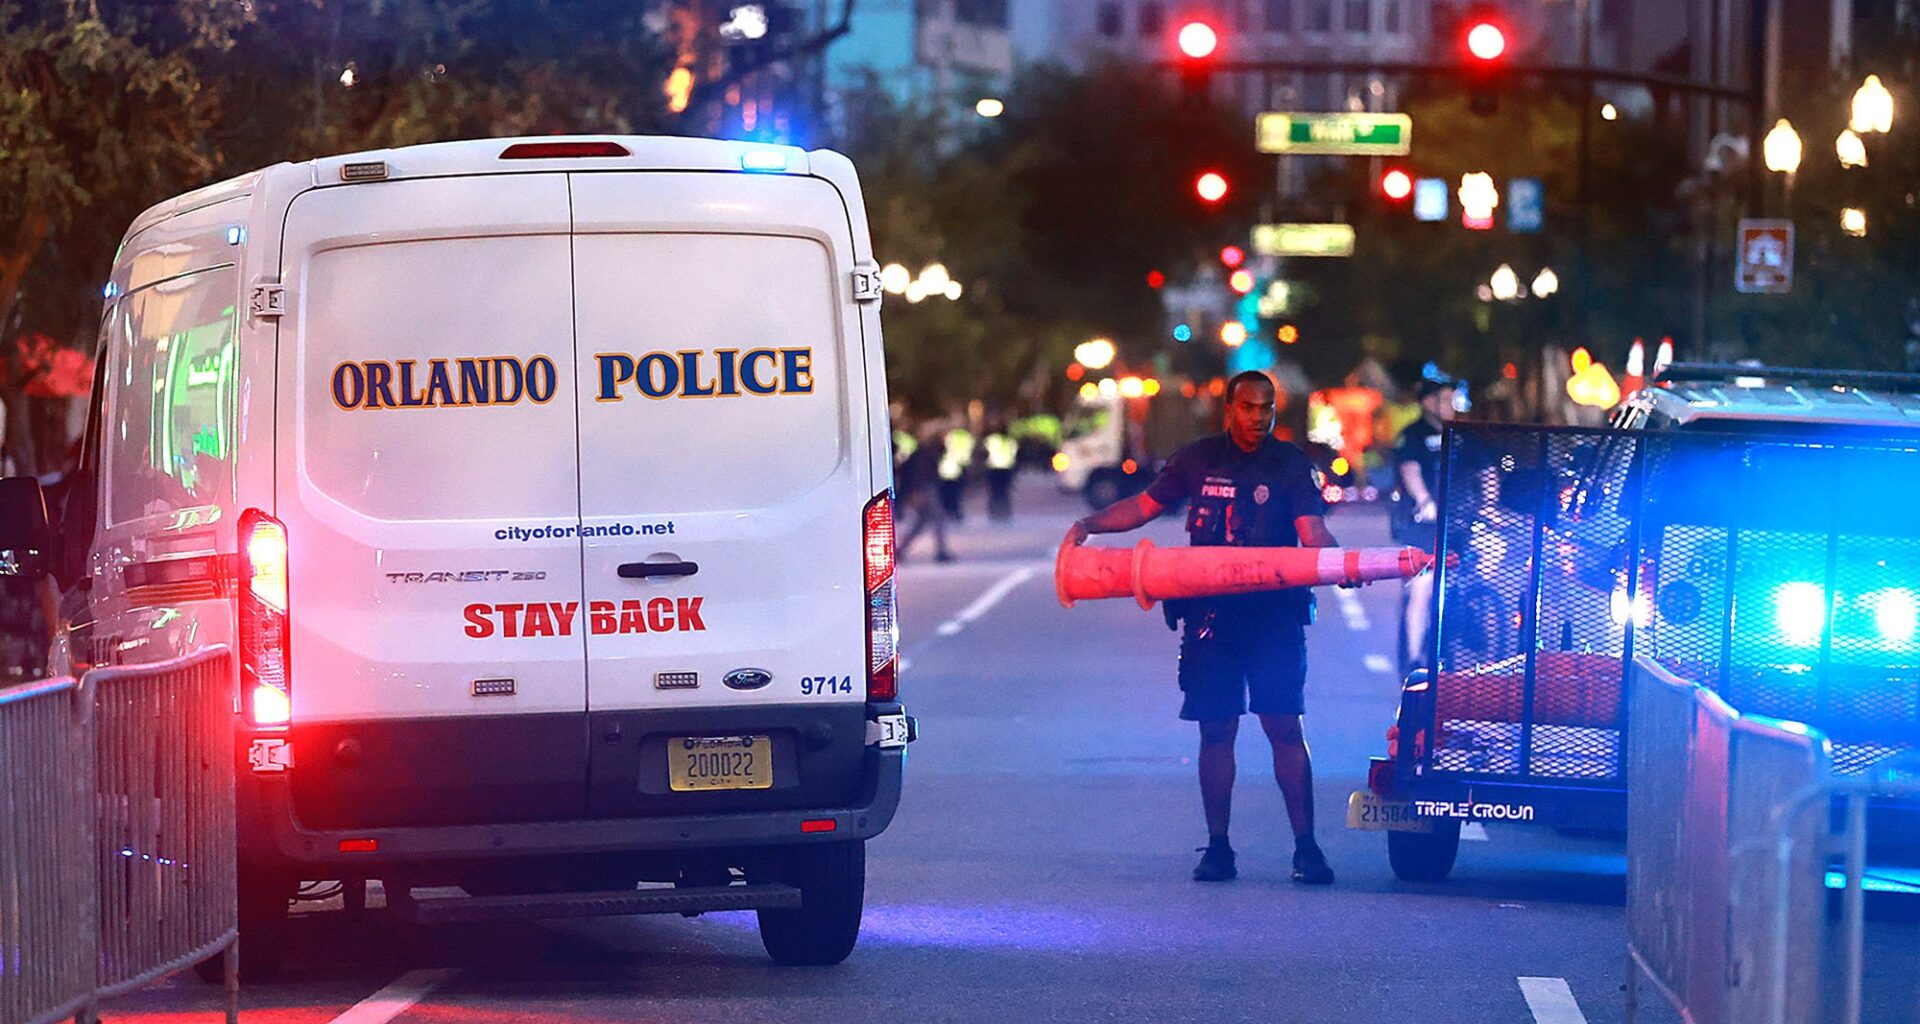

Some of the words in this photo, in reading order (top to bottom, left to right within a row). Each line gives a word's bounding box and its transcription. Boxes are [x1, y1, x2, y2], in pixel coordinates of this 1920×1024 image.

[331, 354, 558, 411] ORLANDO
[594, 346, 815, 402] POLICE
[1201, 485, 1237, 498] POLICE
[494, 521, 675, 541] cityoforlando.net
[386, 570, 509, 583] TRANSIT
[512, 571, 547, 581] 250
[463, 602, 580, 638] STAY
[590, 597, 706, 635] BACK
[801, 676, 852, 695] 9714
[688, 753, 753, 777] 200022
[1415, 801, 1469, 817] TRIPLE
[1473, 803, 1534, 820] CROWN
